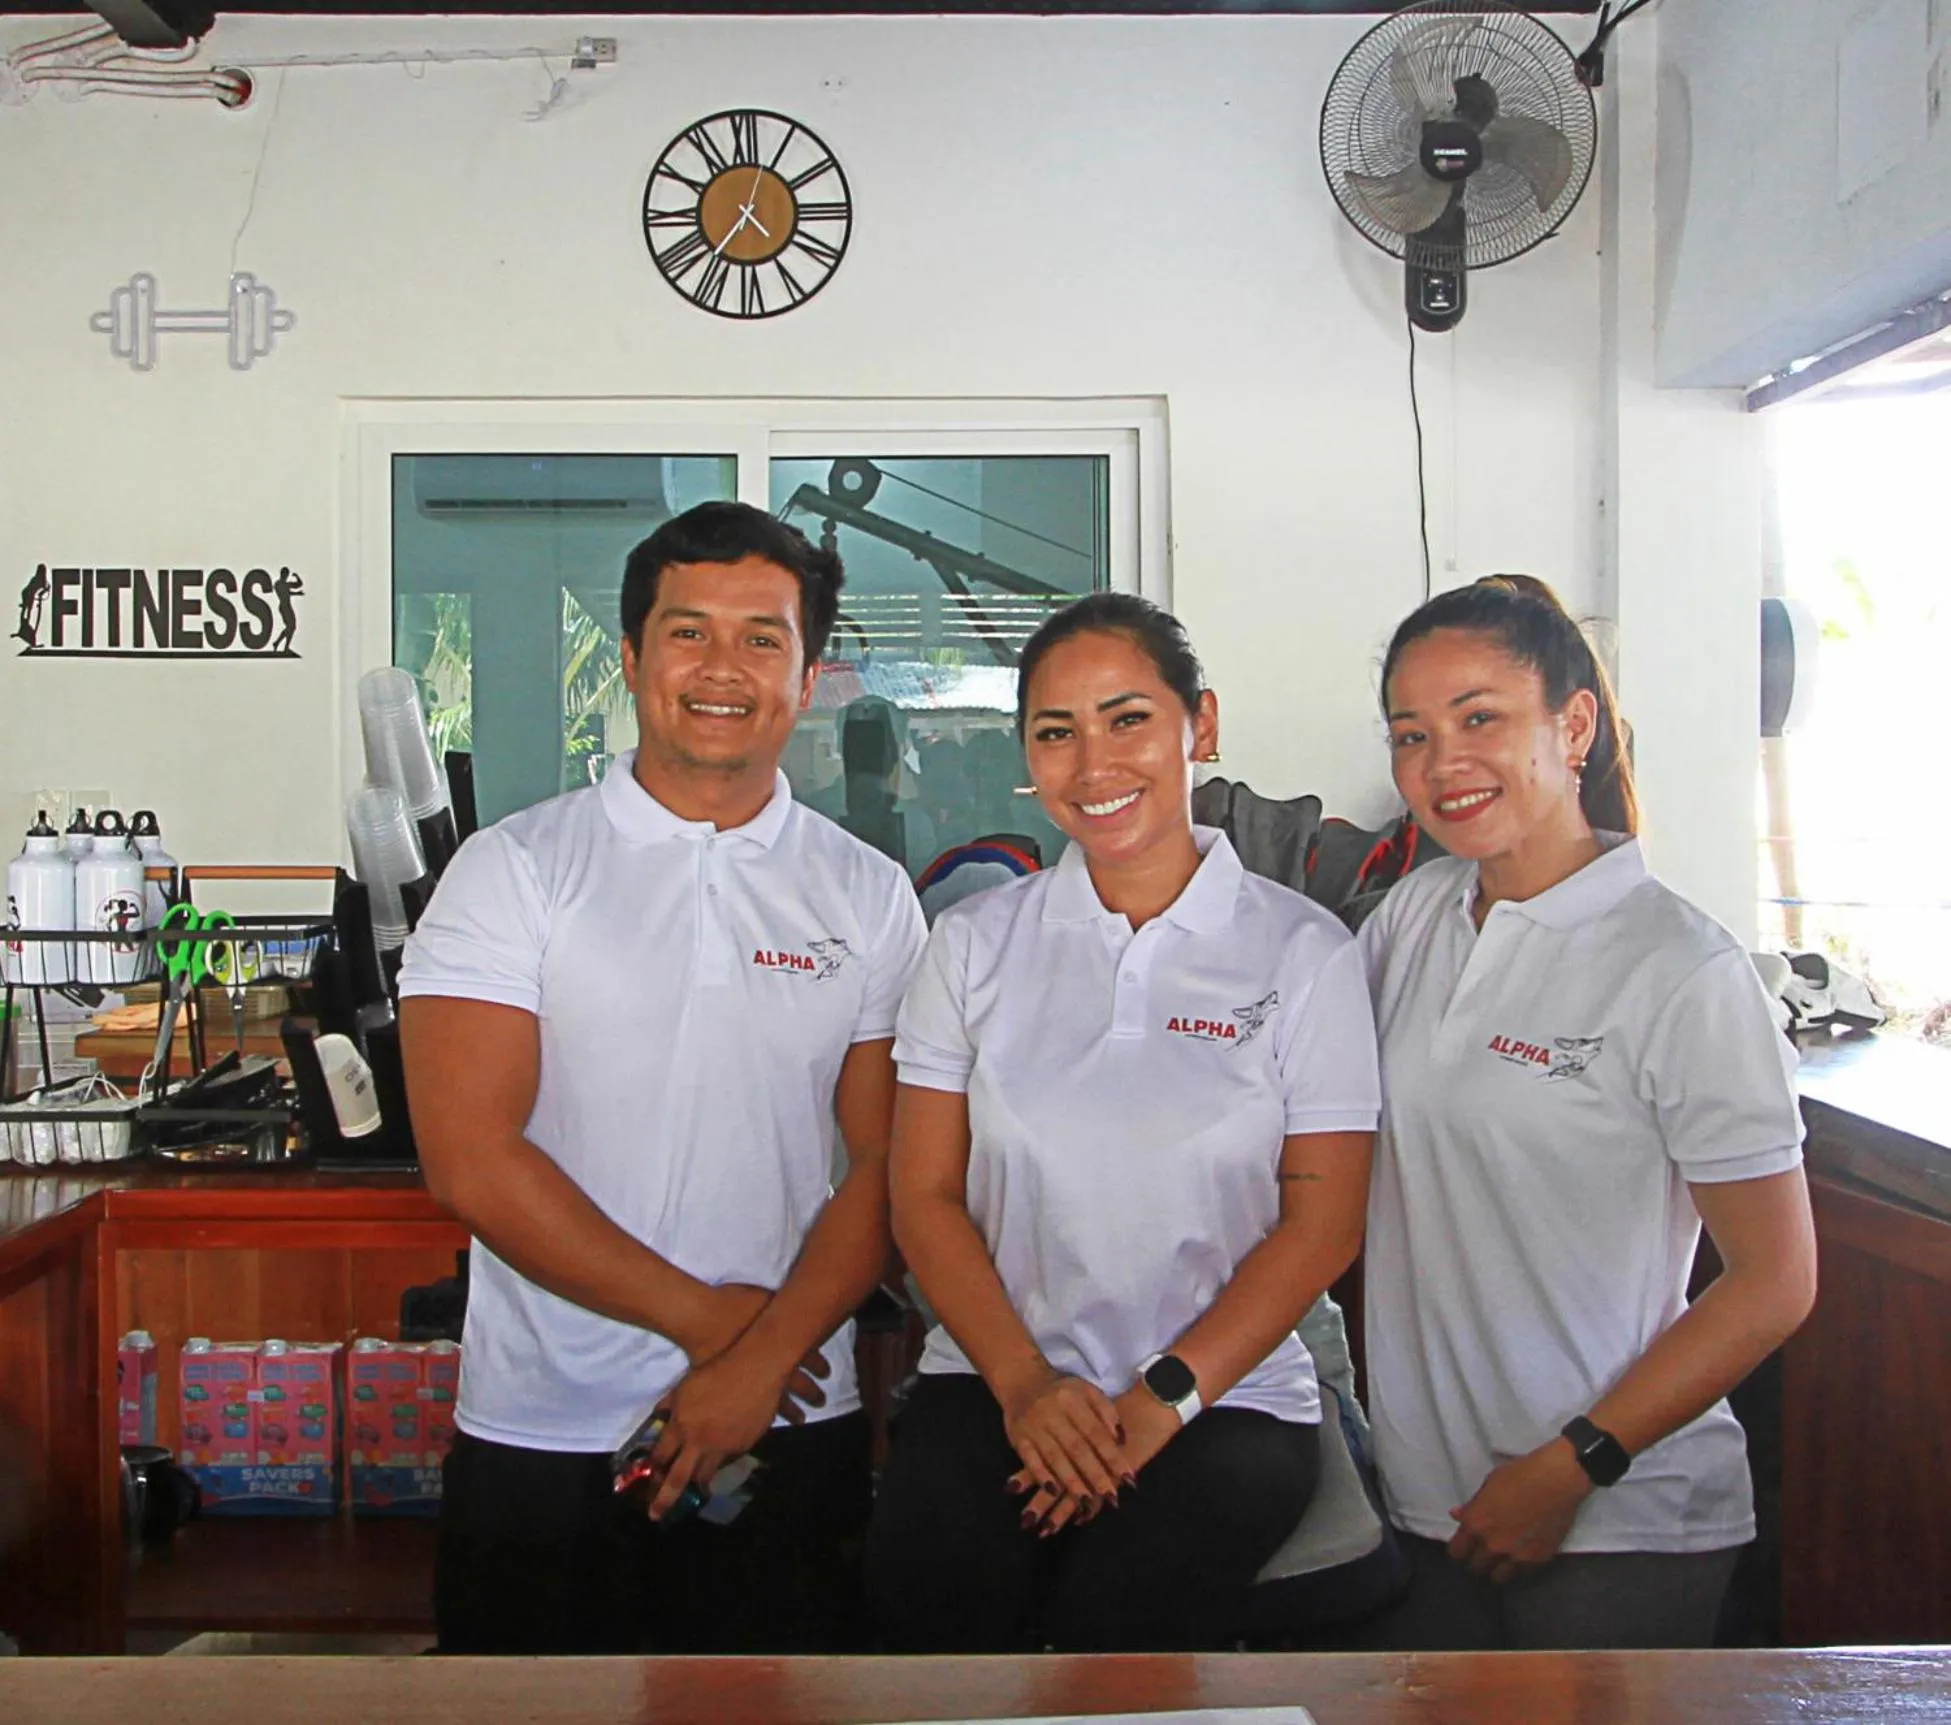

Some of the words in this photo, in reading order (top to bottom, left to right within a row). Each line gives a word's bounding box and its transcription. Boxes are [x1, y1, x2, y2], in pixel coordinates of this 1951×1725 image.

[730, 114, 759, 166] XII
[51, 568, 273, 649] FITNESS
[753, 949, 816, 971] ALPHA
[1166, 1016, 1236, 1038] ALPHA
[1487, 1034, 1551, 1066] ALPHA
[241, 1467, 316, 1481] SAVERS
